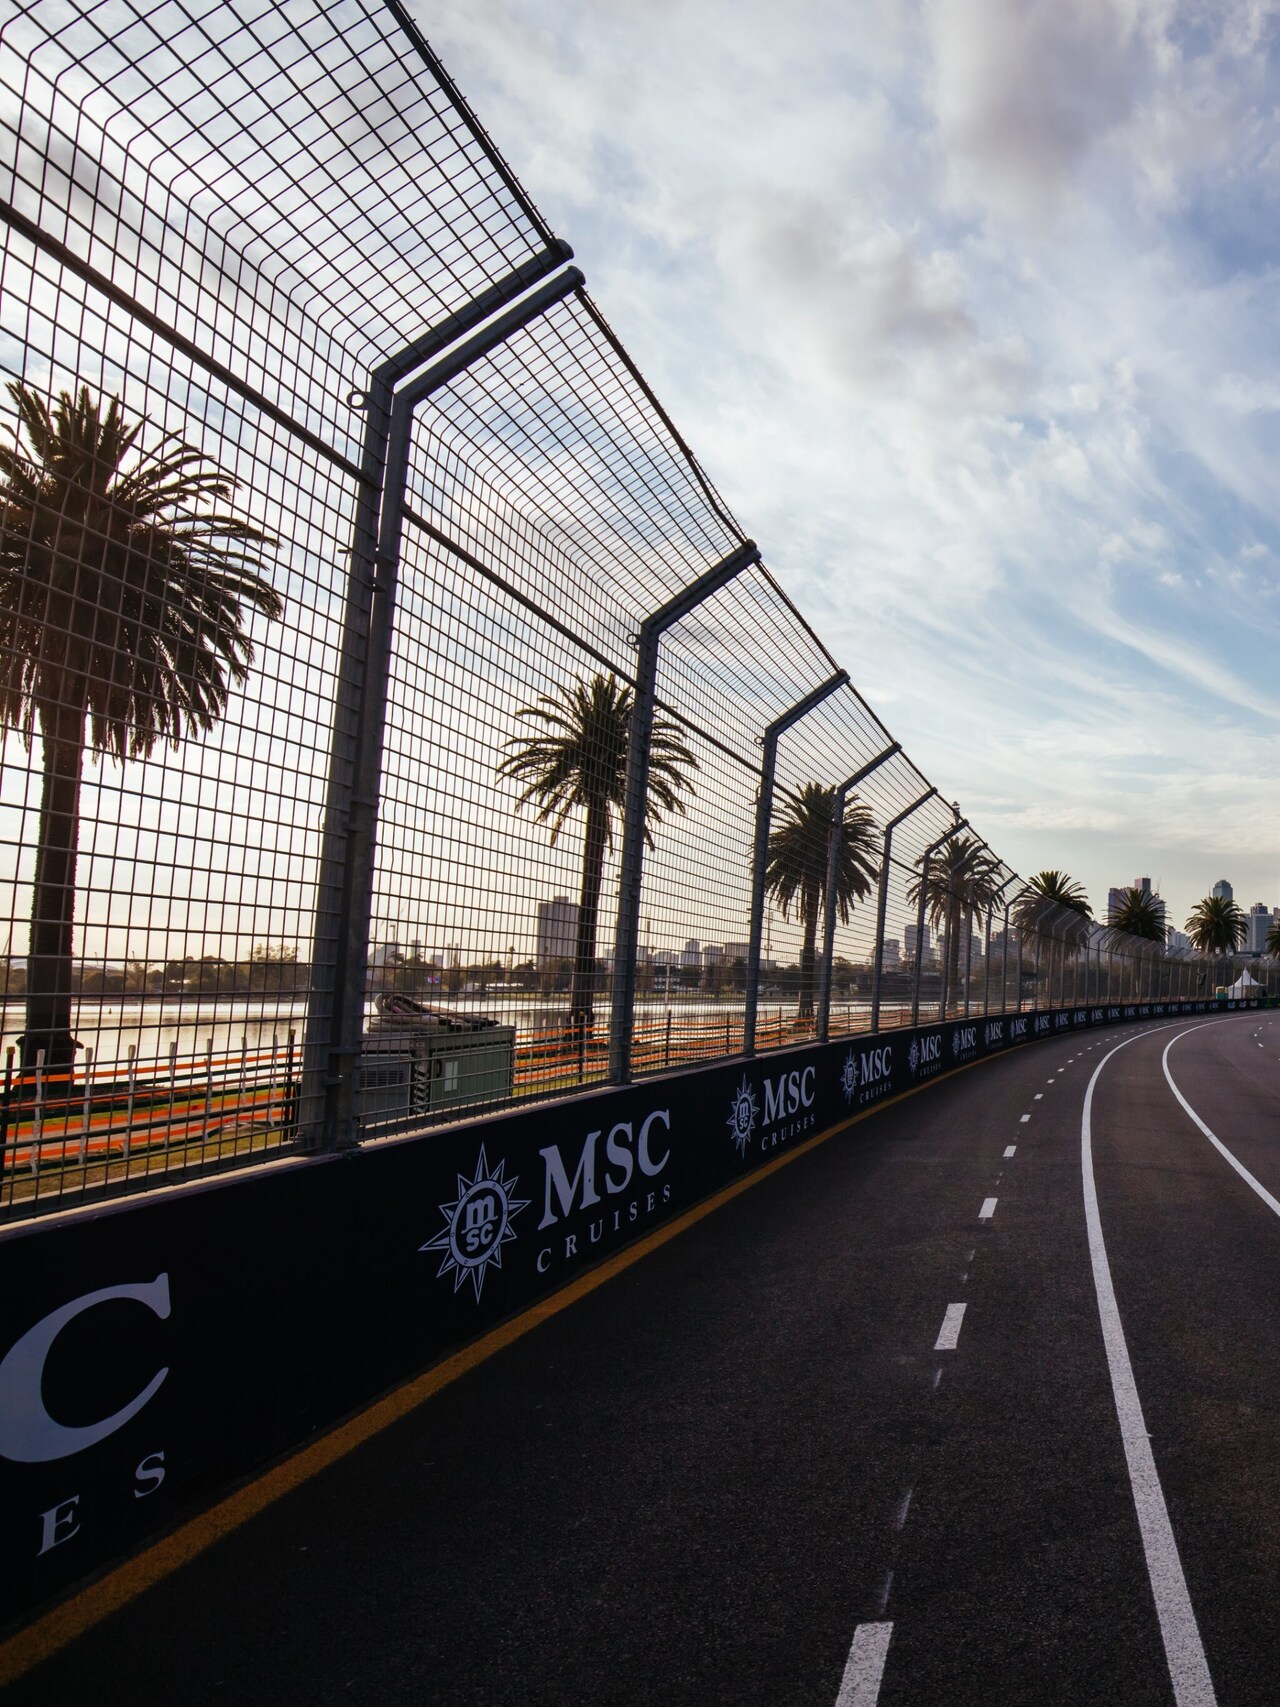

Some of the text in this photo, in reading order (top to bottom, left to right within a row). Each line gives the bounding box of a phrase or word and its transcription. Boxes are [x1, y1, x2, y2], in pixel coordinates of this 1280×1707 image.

[921, 1035, 941, 1063] MSC
[961, 1028, 976, 1050] MSC
[990, 1022, 1003, 1040] MSC
[860, 1046, 892, 1085] MSC
[762, 1066, 815, 1126] MSC
[860, 1082, 892, 1104] CRUISES
[762, 1114, 815, 1150] CRUISES
[537, 1109, 670, 1231] MSC
[536, 1184, 671, 1273] CRUISES
